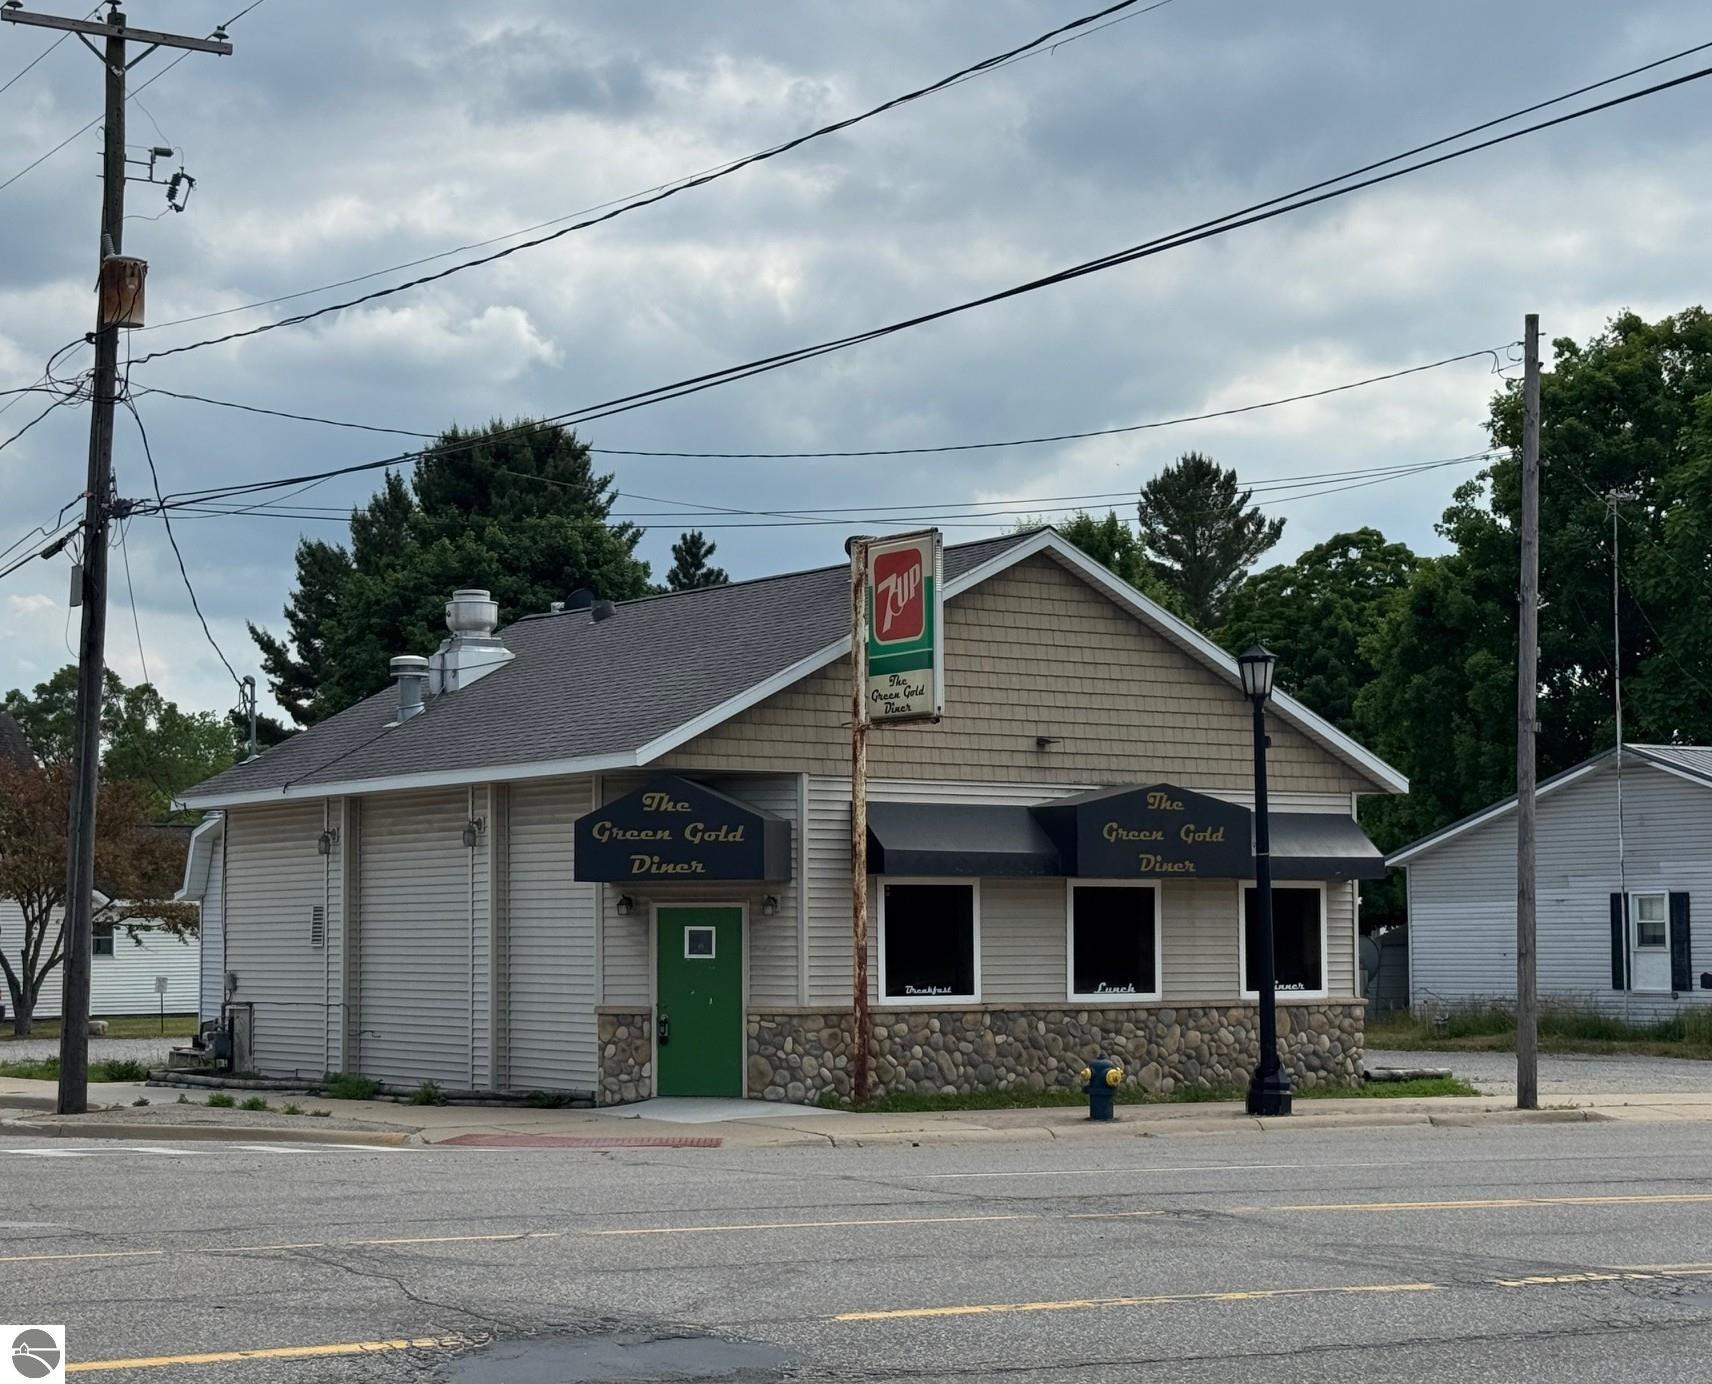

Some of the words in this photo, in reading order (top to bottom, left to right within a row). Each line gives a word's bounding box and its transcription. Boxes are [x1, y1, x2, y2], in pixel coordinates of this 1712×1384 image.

[877, 563, 921, 633] 7UP
[889, 674, 908, 687] The
[871, 689, 900, 702] Green
[903, 685, 925, 698] Gold
[884, 702, 912, 714] Diner
[642, 792, 692, 812] The
[1146, 792, 1184, 811] The
[592, 821, 672, 842] Green
[684, 822, 744, 844] Gold
[1102, 822, 1165, 842] Green
[1180, 824, 1224, 844] Gold
[629, 854, 706, 874] Diner
[1139, 854, 1196, 872] Diner
[904, 985, 952, 995] Breakfast
[1093, 982, 1136, 993] Lunch
[1274, 980, 1305, 990] inner
